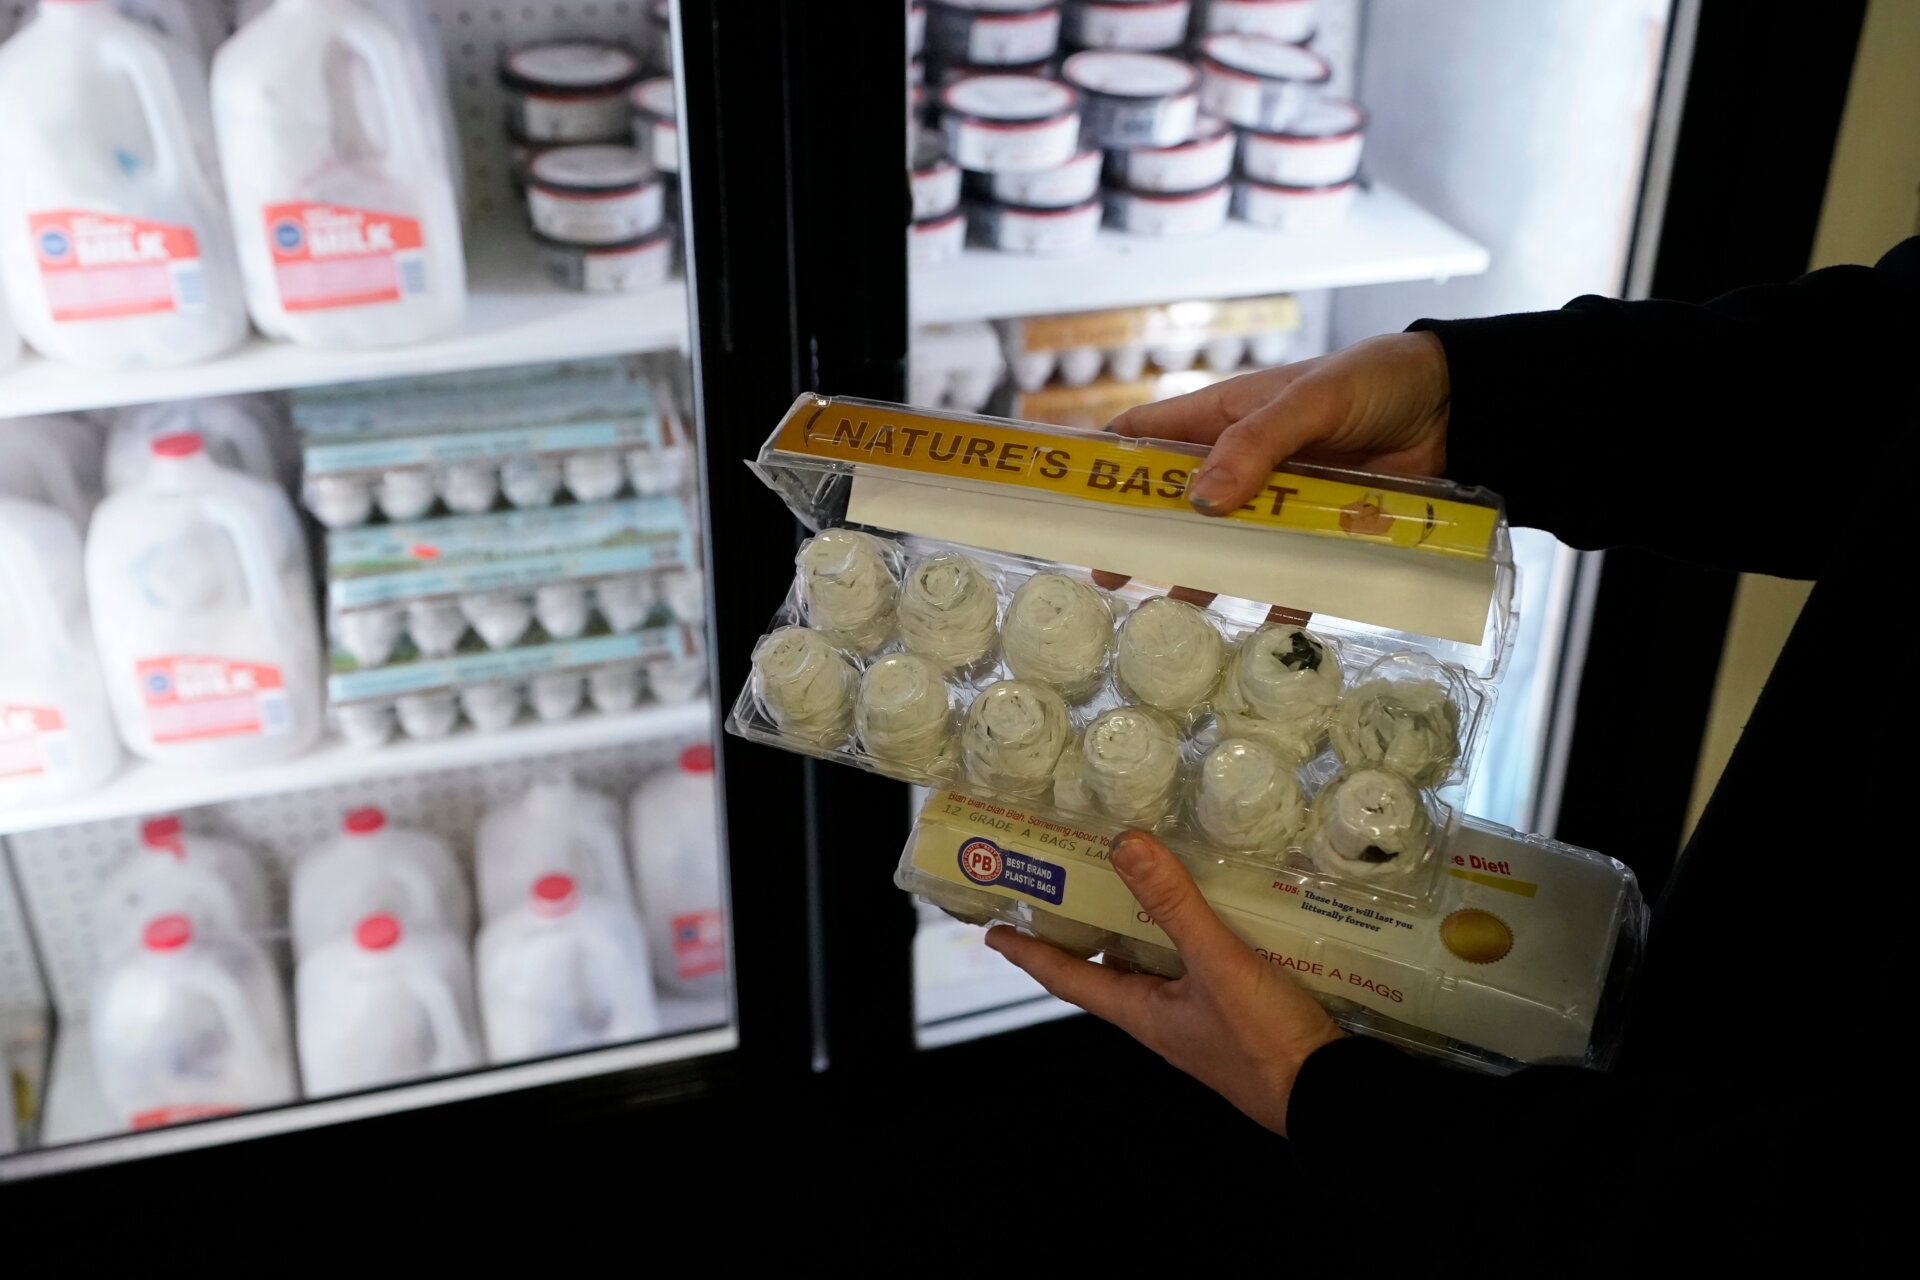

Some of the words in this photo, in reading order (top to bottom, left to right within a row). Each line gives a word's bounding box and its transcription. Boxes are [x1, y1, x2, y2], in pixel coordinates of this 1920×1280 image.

[831, 418, 1071, 479] NATURE'S
[1086, 458, 1298, 516] BAST
[943, 804, 962, 816] 12
[969, 811, 1016, 833] GRADE
[1020, 828, 1031, 838] A
[1039, 833, 1077, 851] BAGS
[972, 852, 992, 872] PB
[1006, 857, 1026, 870] BEST
[1027, 863, 1052, 879] BRAND
[1469, 855, 1511, 876] Diet!
[1005, 870, 1035, 888] PLASTIC
[1036, 881, 1056, 895] BAGS
[1272, 881, 1300, 896] PLUS:
[1301, 902, 1344, 923] litterally
[1345, 915, 1381, 932] forever
[1304, 890, 1331, 905] These
[1331, 899, 1354, 914] bags
[1355, 907, 1374, 919] will
[1374, 912, 1394, 924] last
[1394, 919, 1414, 930] you
[1327, 968, 1343, 981] A
[1348, 973, 1404, 1003] BAGS
